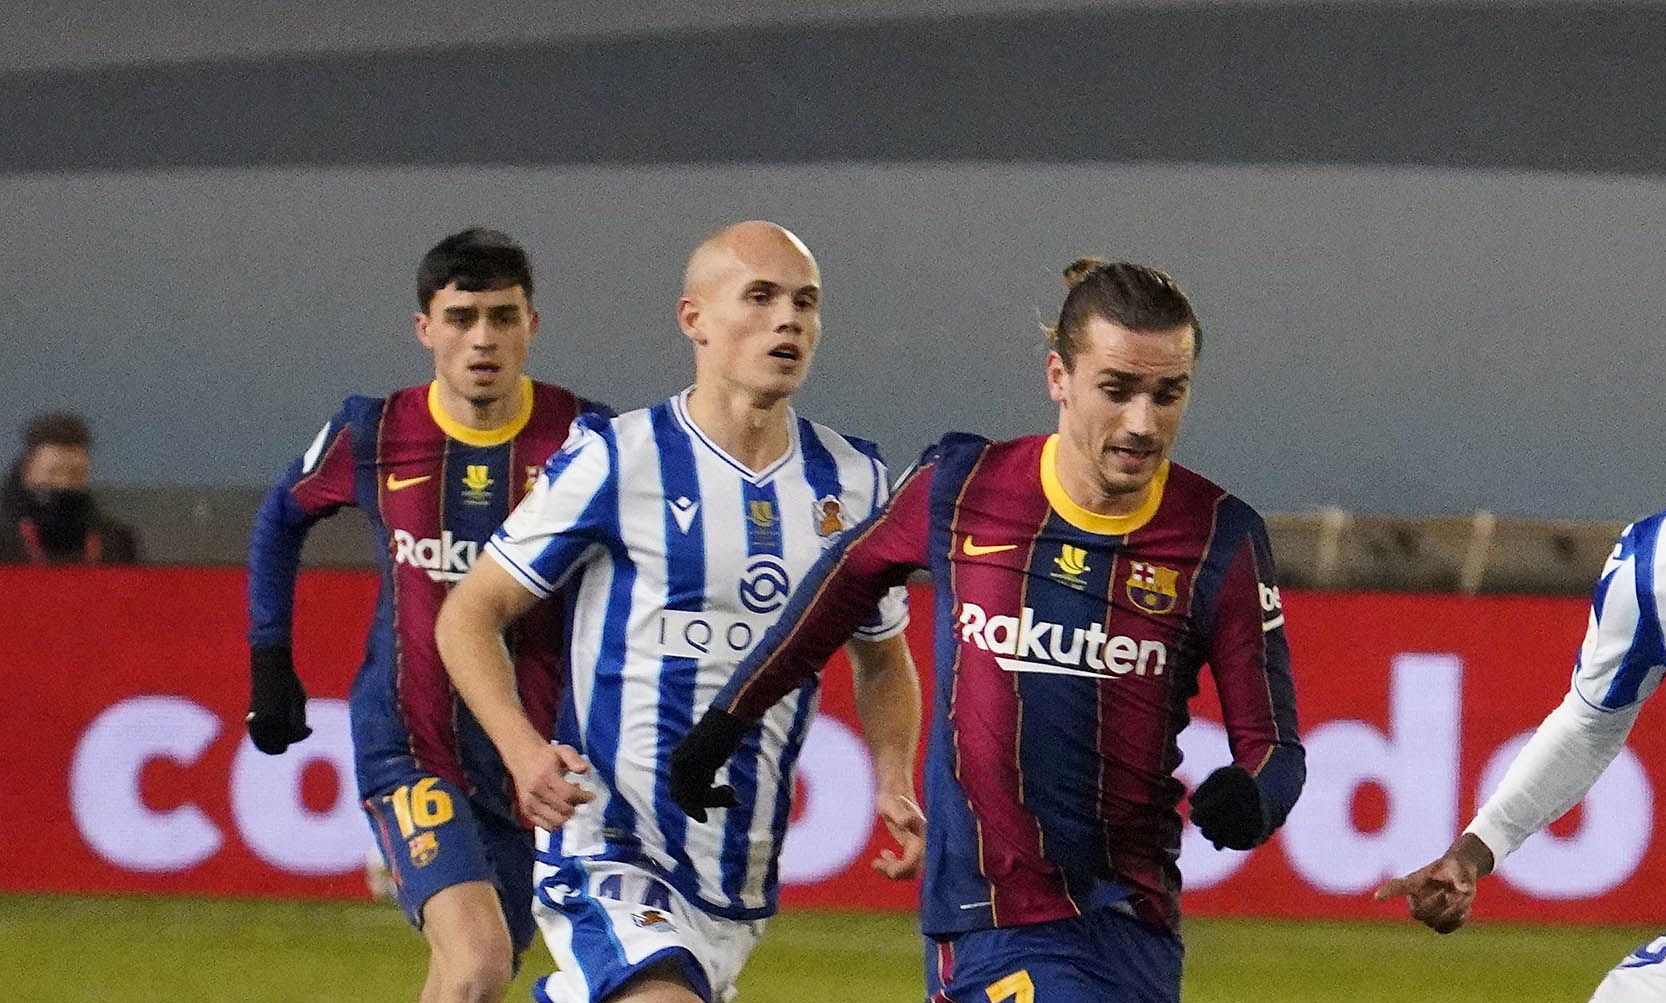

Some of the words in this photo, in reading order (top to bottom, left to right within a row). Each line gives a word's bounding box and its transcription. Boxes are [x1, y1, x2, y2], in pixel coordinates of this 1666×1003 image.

[659, 617, 753, 654] IQO
[960, 603, 1167, 676] Rakuten
[382, 776, 454, 838] 16
